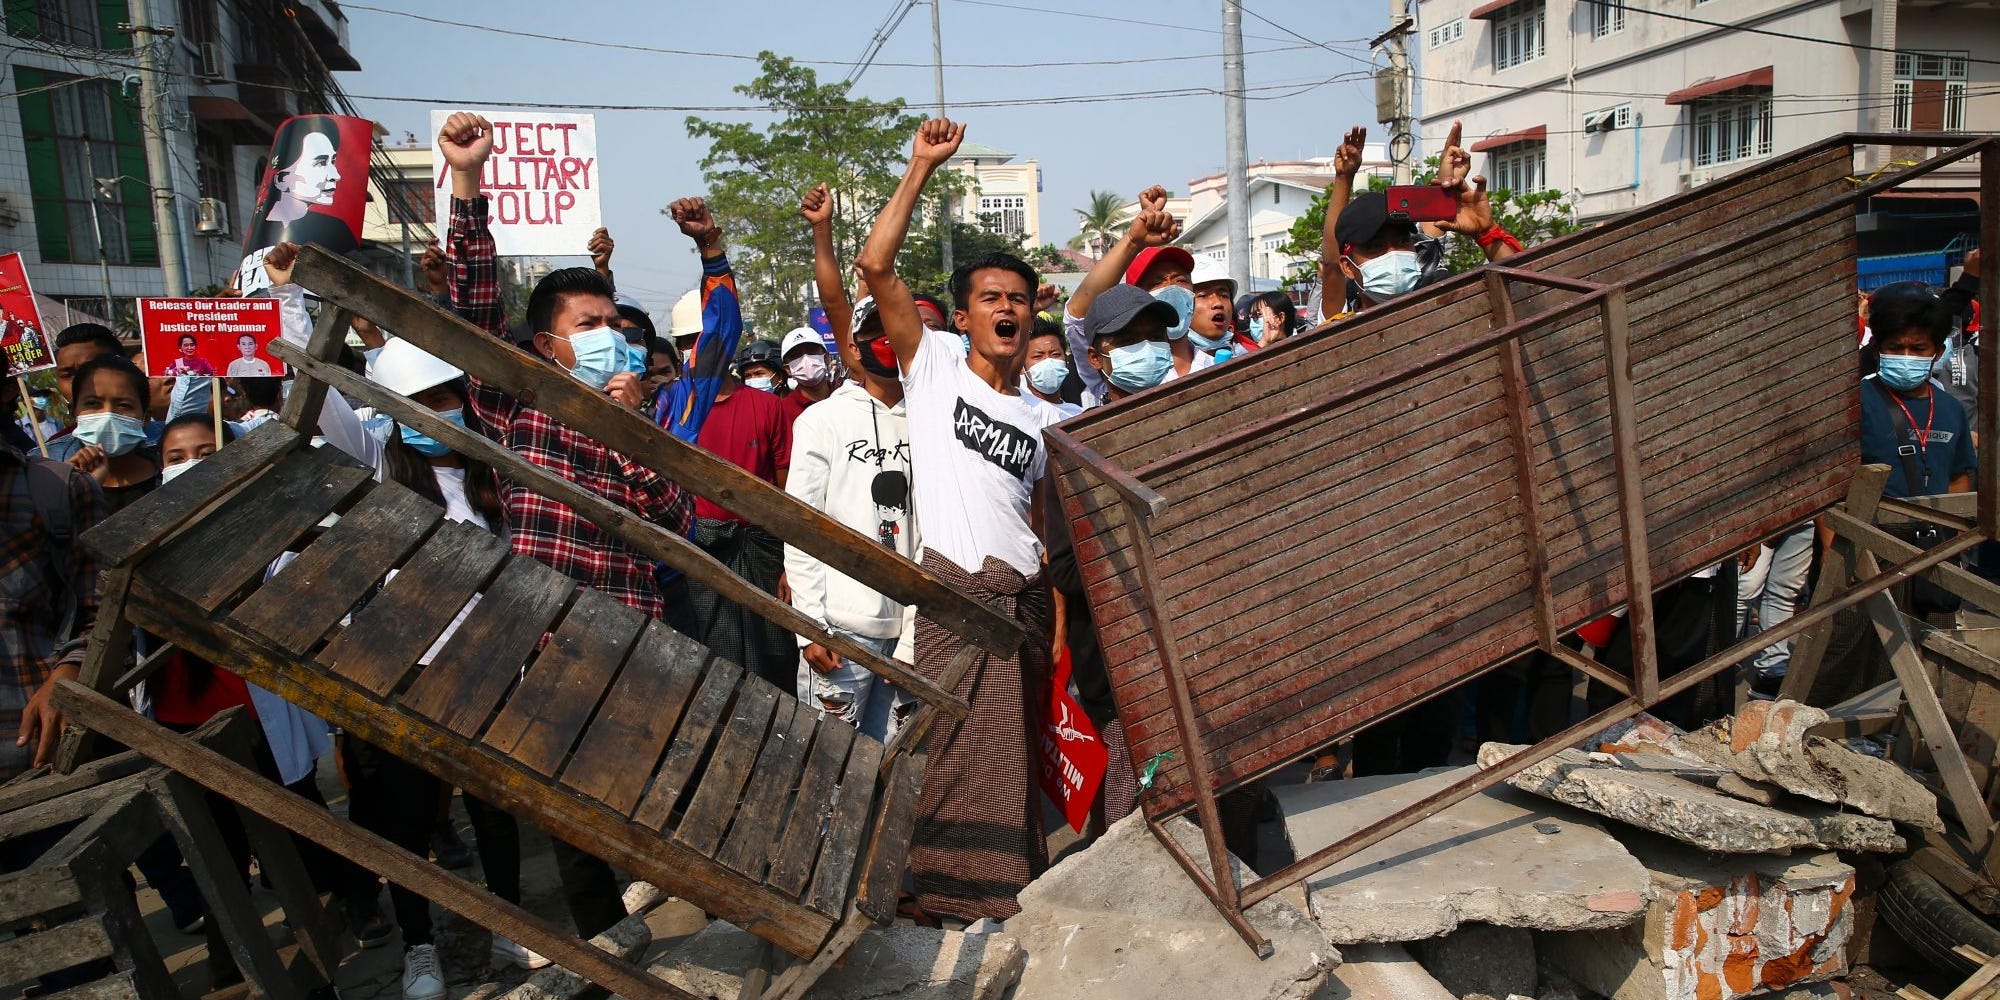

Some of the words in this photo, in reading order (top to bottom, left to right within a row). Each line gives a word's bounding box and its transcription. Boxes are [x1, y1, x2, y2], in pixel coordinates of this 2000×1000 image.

[489, 122, 577, 156] JECT
[437, 157, 594, 190] ILITARY
[149, 301, 193, 310] Release
[195, 301, 213, 310] Our
[215, 301, 251, 310] Leader
[253, 301, 272, 311] and
[187, 312, 238, 321] President
[160, 323, 197, 332] Justice
[199, 323, 216, 332] For
[218, 323, 267, 333] Myanmar
[12, 349, 43, 364] EADER
[955, 407, 1031, 473] ARMANI
